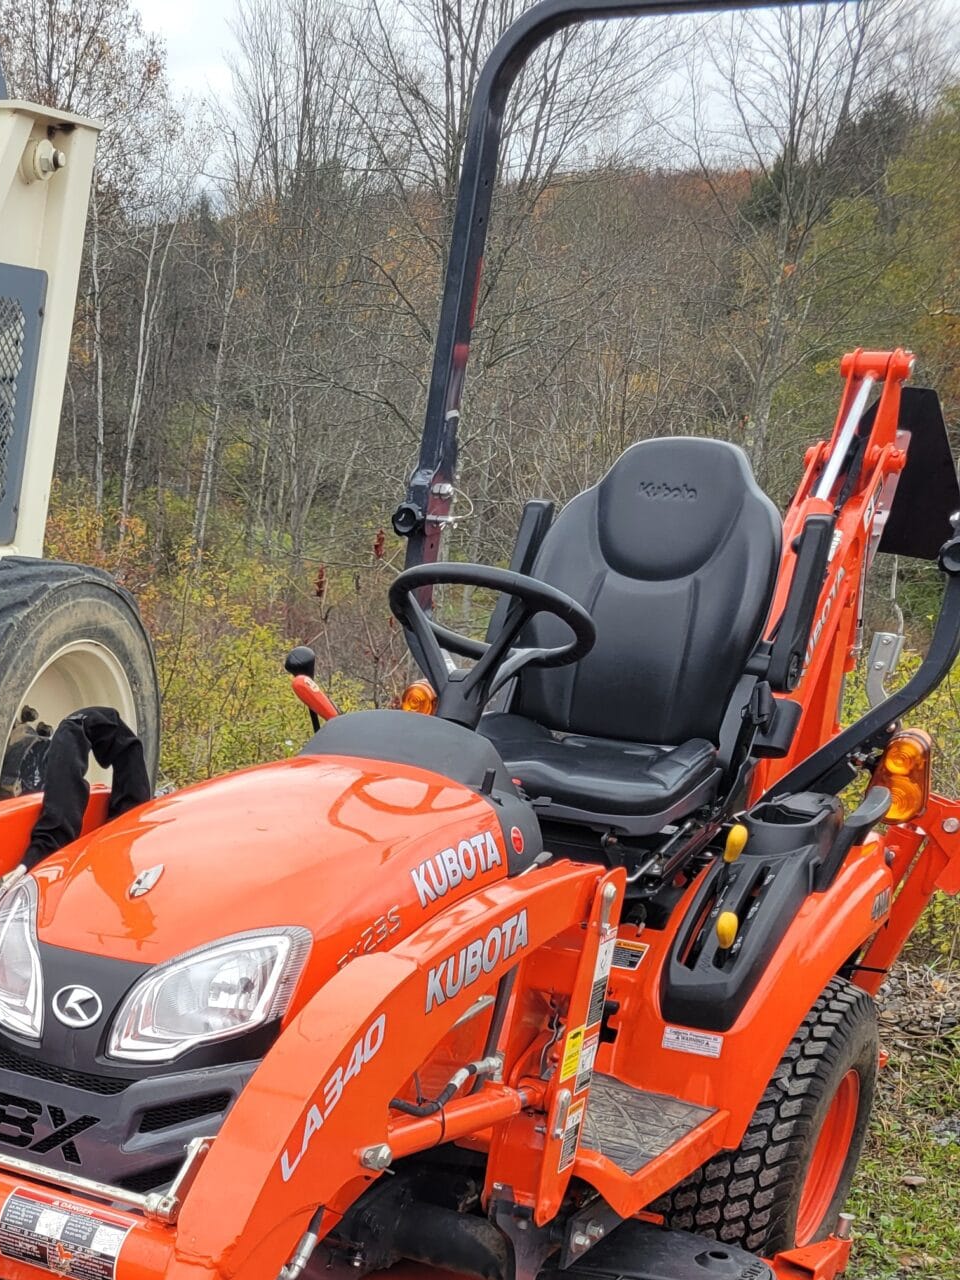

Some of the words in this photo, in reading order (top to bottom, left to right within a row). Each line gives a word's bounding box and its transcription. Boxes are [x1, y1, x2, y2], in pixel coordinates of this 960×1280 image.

[410, 830, 502, 909] KUBOTA
[425, 907, 529, 1015] KUBOTA
[280, 1013, 386, 1182] LA340
[60, 1200, 94, 1216] DANGER
